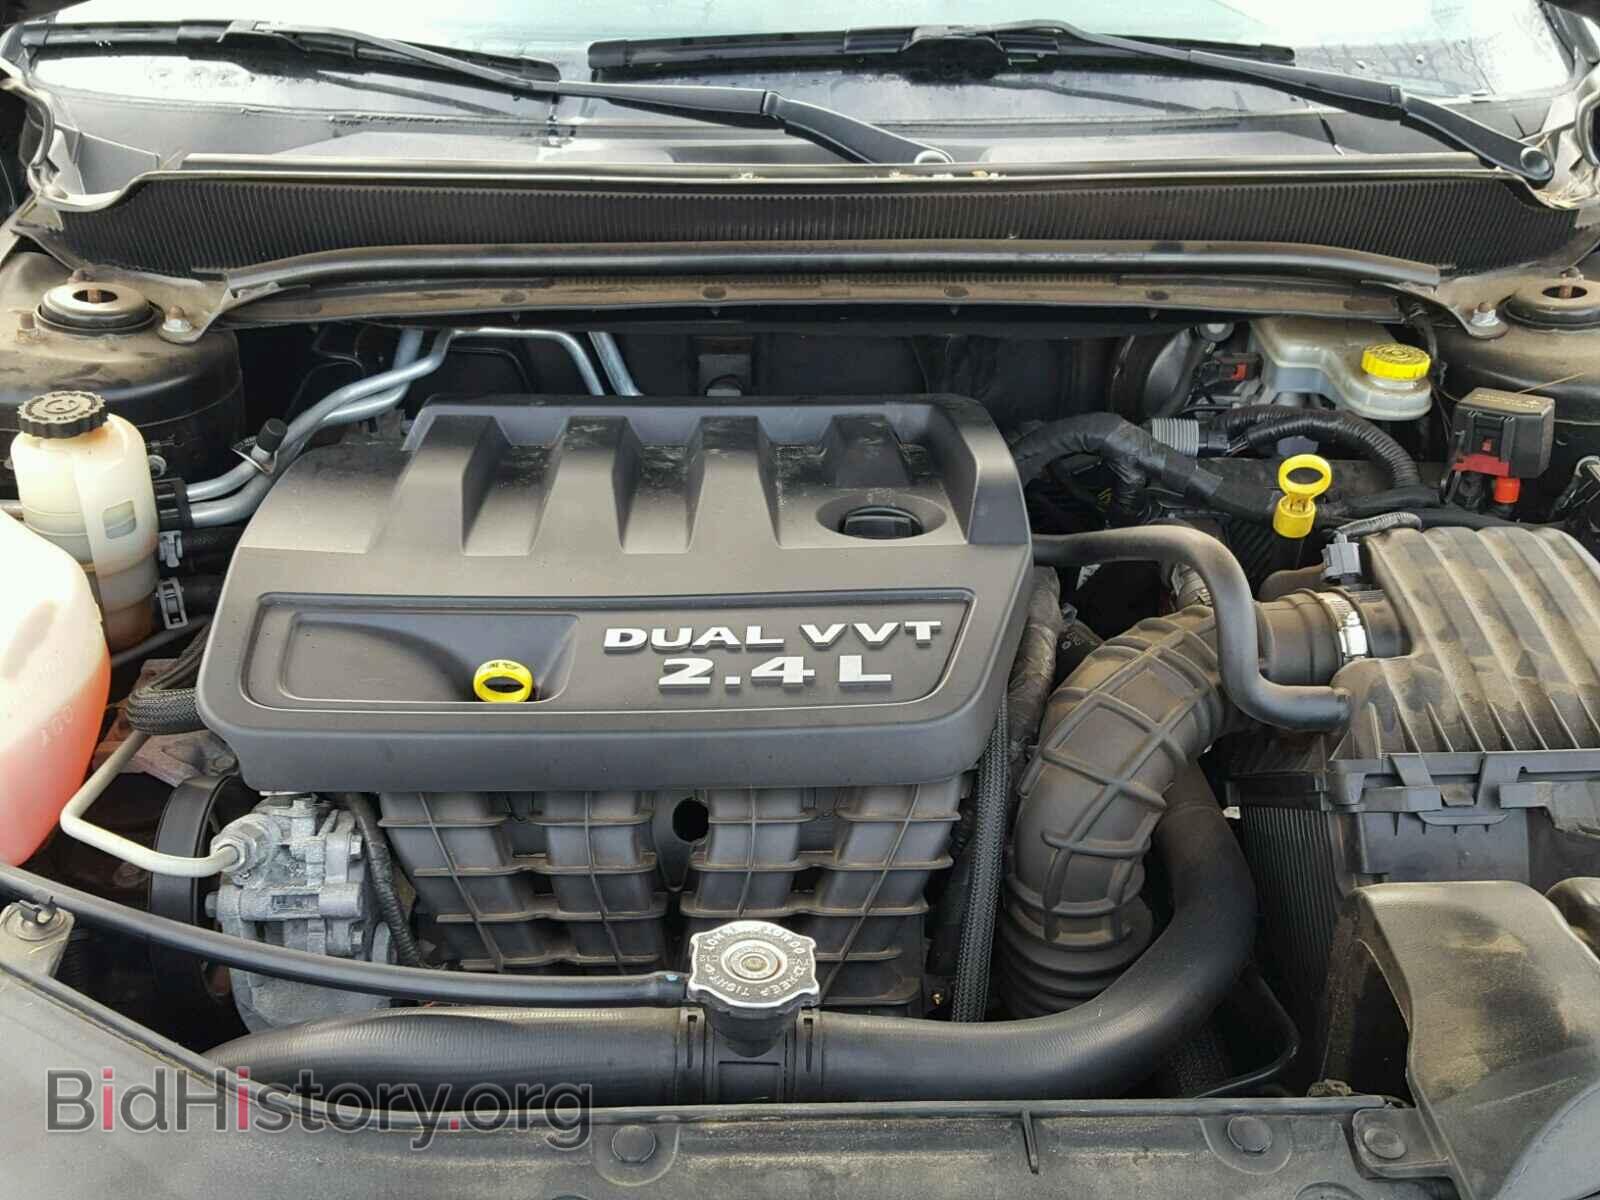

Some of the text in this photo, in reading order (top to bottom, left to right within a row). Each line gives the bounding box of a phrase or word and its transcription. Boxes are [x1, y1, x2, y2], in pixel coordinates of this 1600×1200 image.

[603, 620, 942, 650] DUAL VVT
[658, 655, 892, 687] 2.4 L
